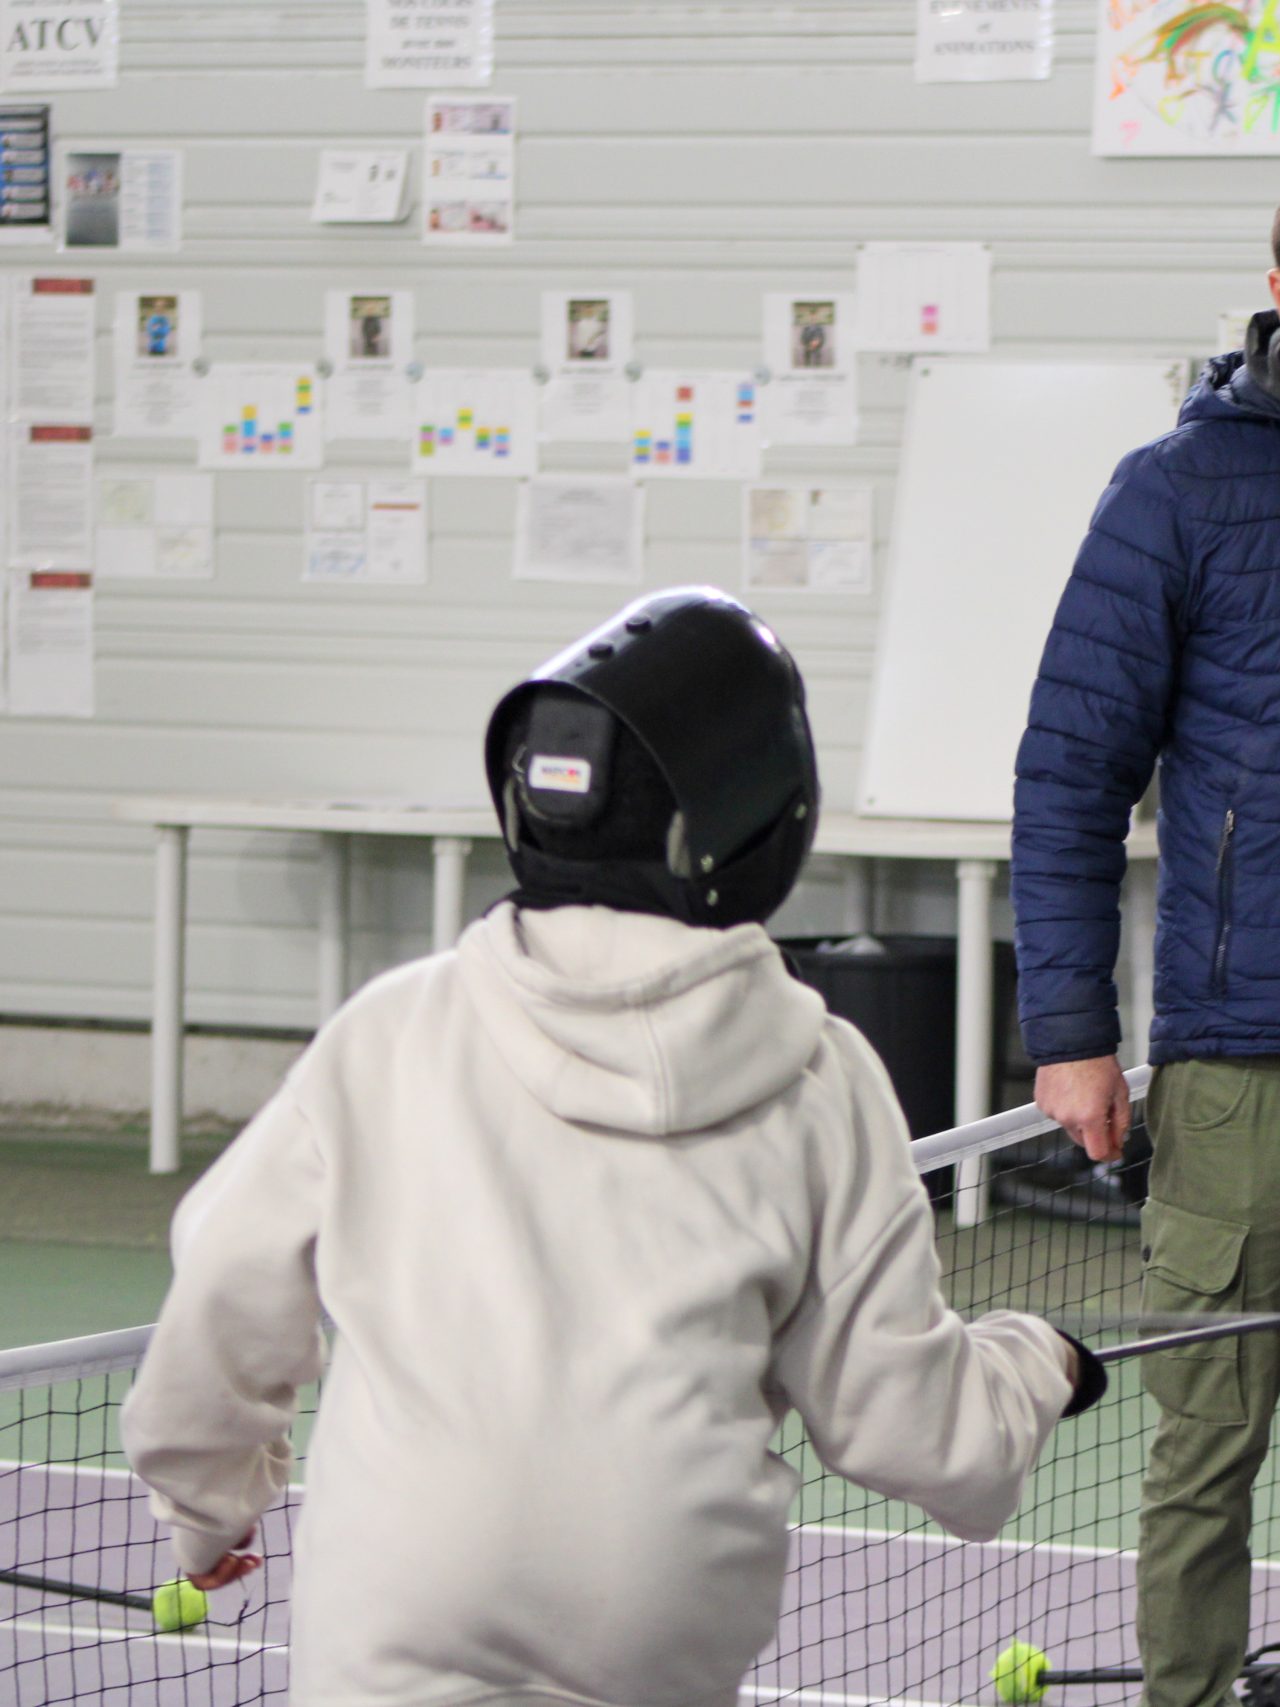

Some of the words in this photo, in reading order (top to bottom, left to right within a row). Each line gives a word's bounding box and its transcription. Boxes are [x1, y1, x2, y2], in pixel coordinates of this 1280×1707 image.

[5, 17, 107, 53] ATCV
[933, 40, 1036, 56] ANIMATIONS
[380, 56, 472, 70] MONITEURS
